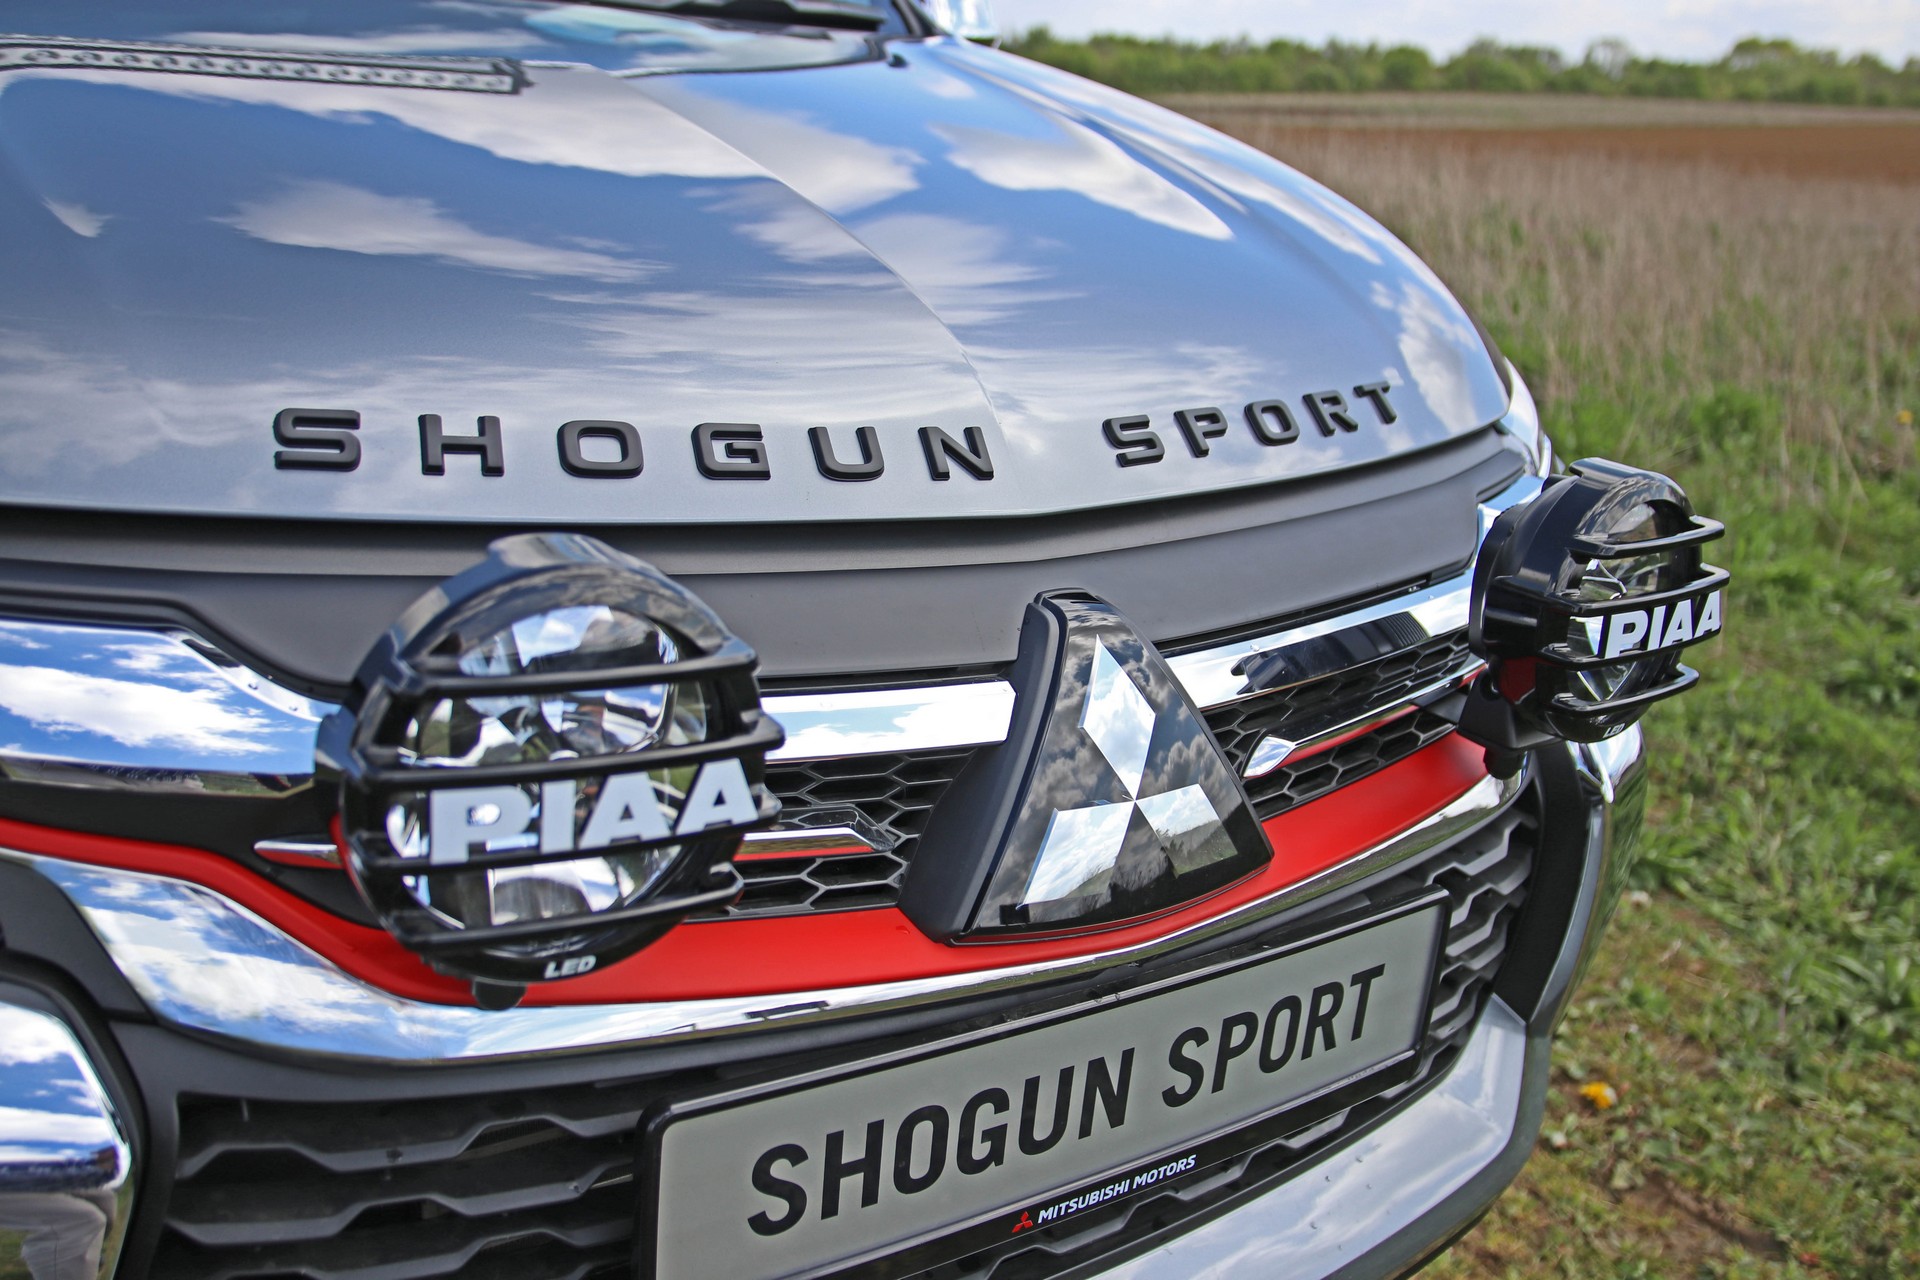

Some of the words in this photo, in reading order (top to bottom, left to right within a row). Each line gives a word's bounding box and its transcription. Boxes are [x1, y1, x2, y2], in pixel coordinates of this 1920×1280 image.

[273, 407, 995, 481] SHOGUN
[1102, 380, 1398, 467] SPORT
[1603, 590, 1722, 659] PIAA
[1602, 722, 1626, 739] LED
[429, 757, 759, 865] PIAA
[544, 955, 597, 979] LED
[747, 1047, 1135, 1237] SHOGUN
[1161, 964, 1386, 1108] SPORT
[1037, 1178, 1131, 1224] MITSUBISHI
[1132, 1154, 1197, 1190] MOTORS
